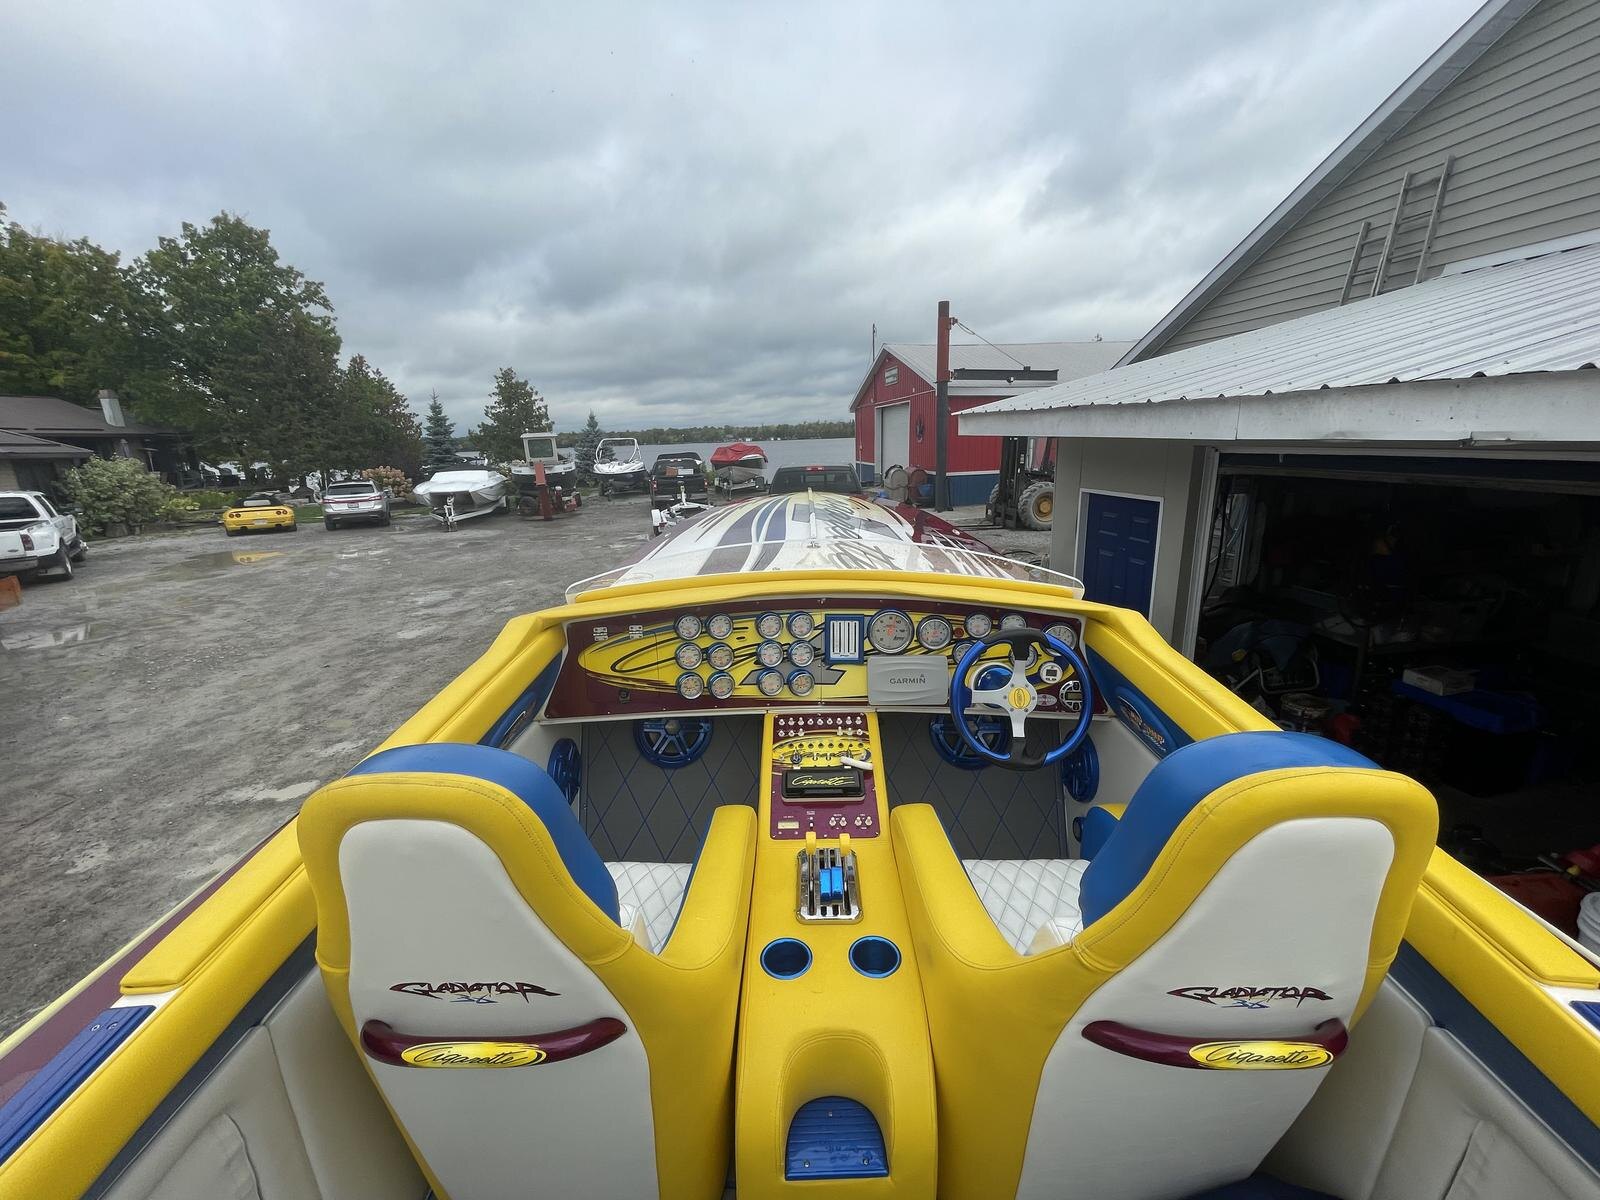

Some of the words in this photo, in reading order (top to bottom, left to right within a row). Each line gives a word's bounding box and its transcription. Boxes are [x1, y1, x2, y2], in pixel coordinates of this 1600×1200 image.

[889, 677, 926, 685] GARMIN
[390, 981, 561, 1003] GLADIATOR
[1166, 986, 1334, 1008] GLADIATOR
[414, 1045, 527, 1066] Cigarette
[1205, 1044, 1321, 1065] Cigarette
